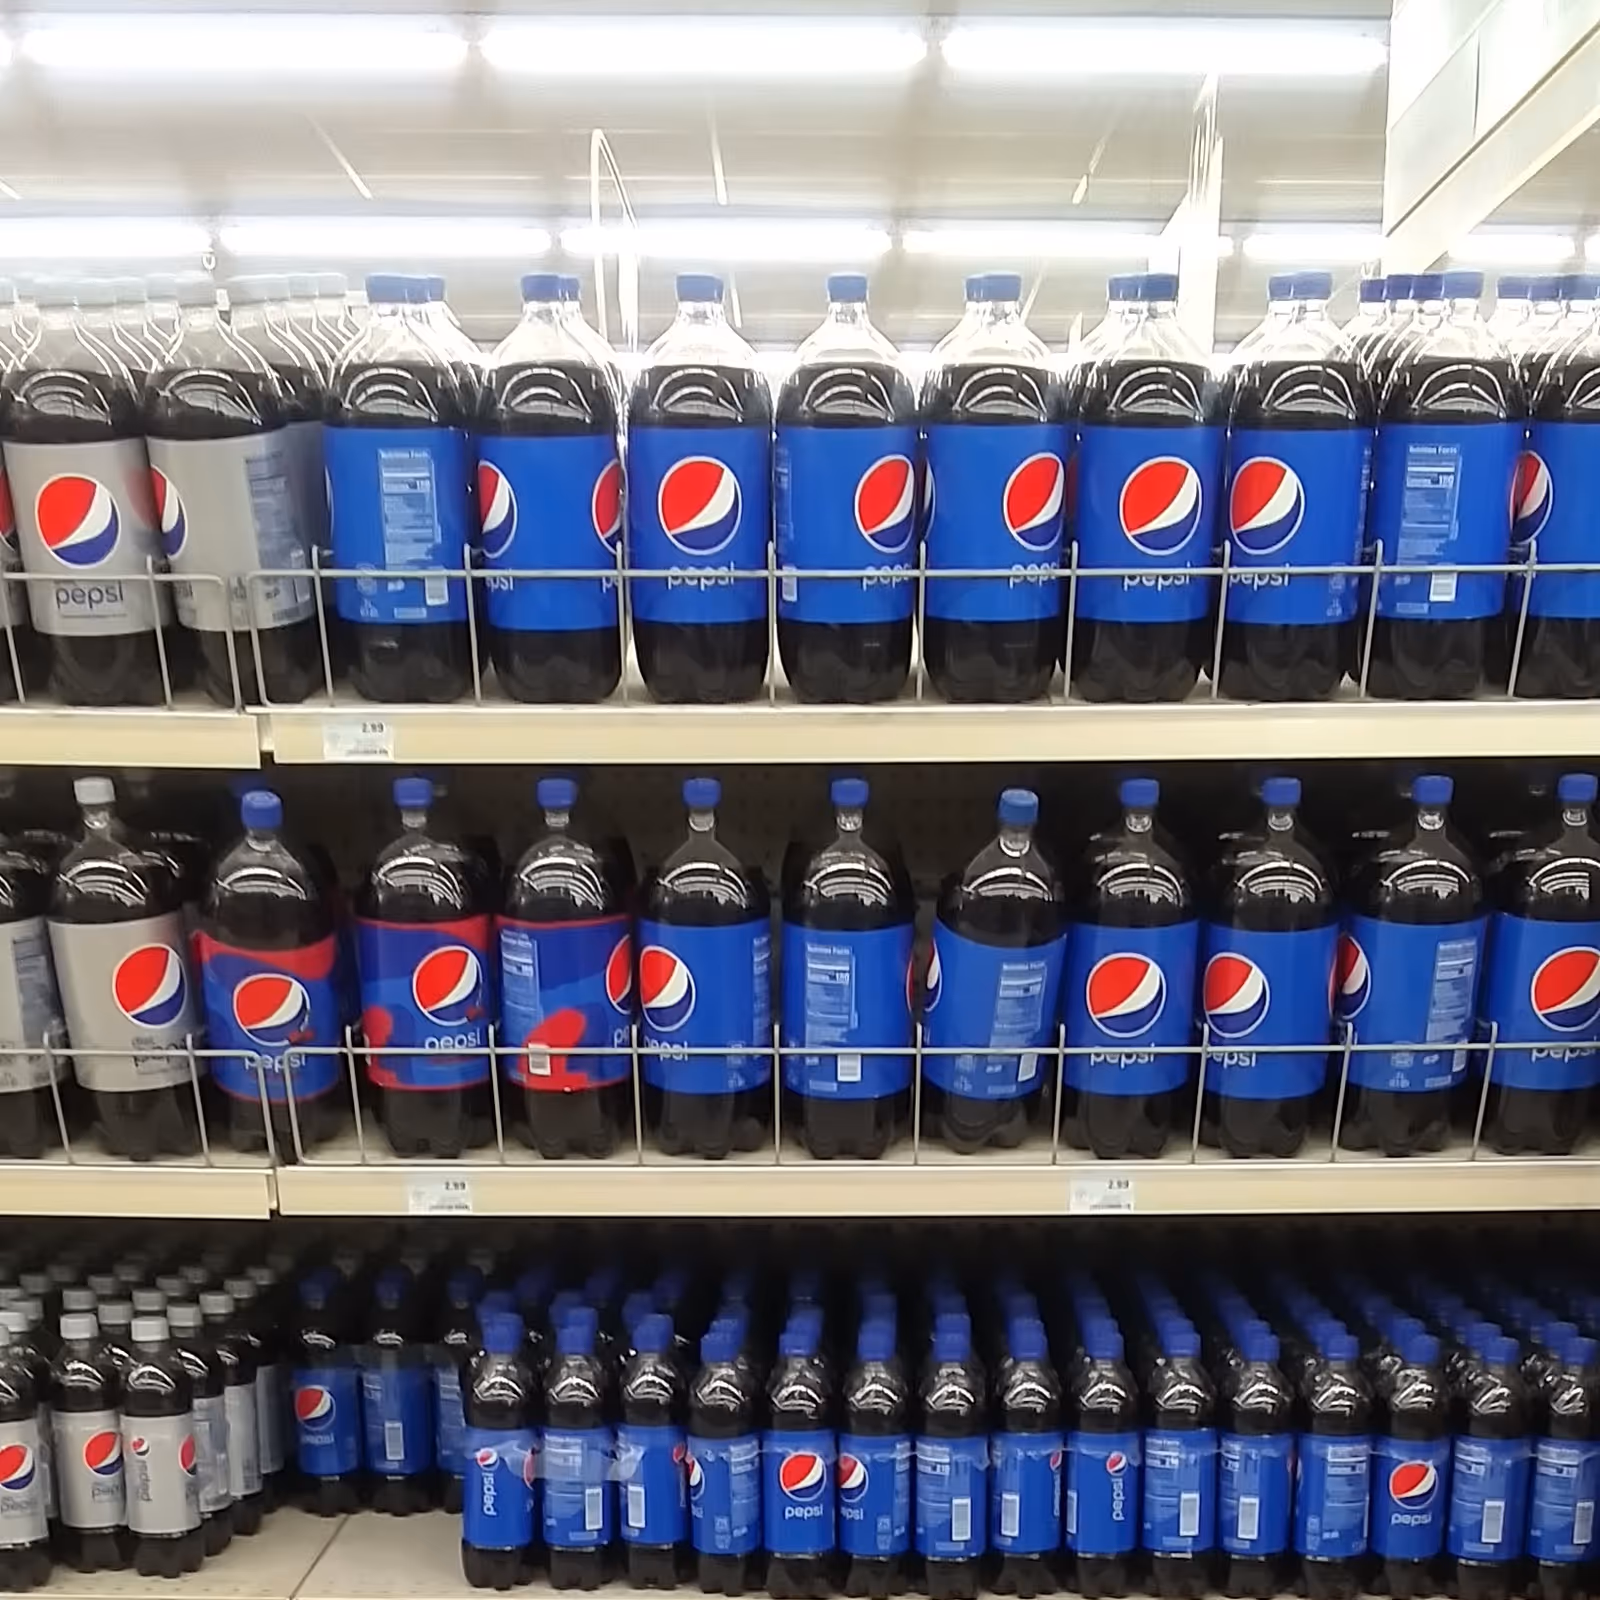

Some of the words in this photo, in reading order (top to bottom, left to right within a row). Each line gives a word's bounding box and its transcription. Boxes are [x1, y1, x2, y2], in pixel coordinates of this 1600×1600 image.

[668, 561, 734, 590] pepsi
[1123, 562, 1191, 591] pepsi
[55, 584, 124, 610] pepsi
[483, 1473, 497, 1516] pepsi
[1113, 1478, 1124, 1521] pepsi
[785, 1504, 823, 1520] pepsi
[1391, 1512, 1431, 1526] pepsi
